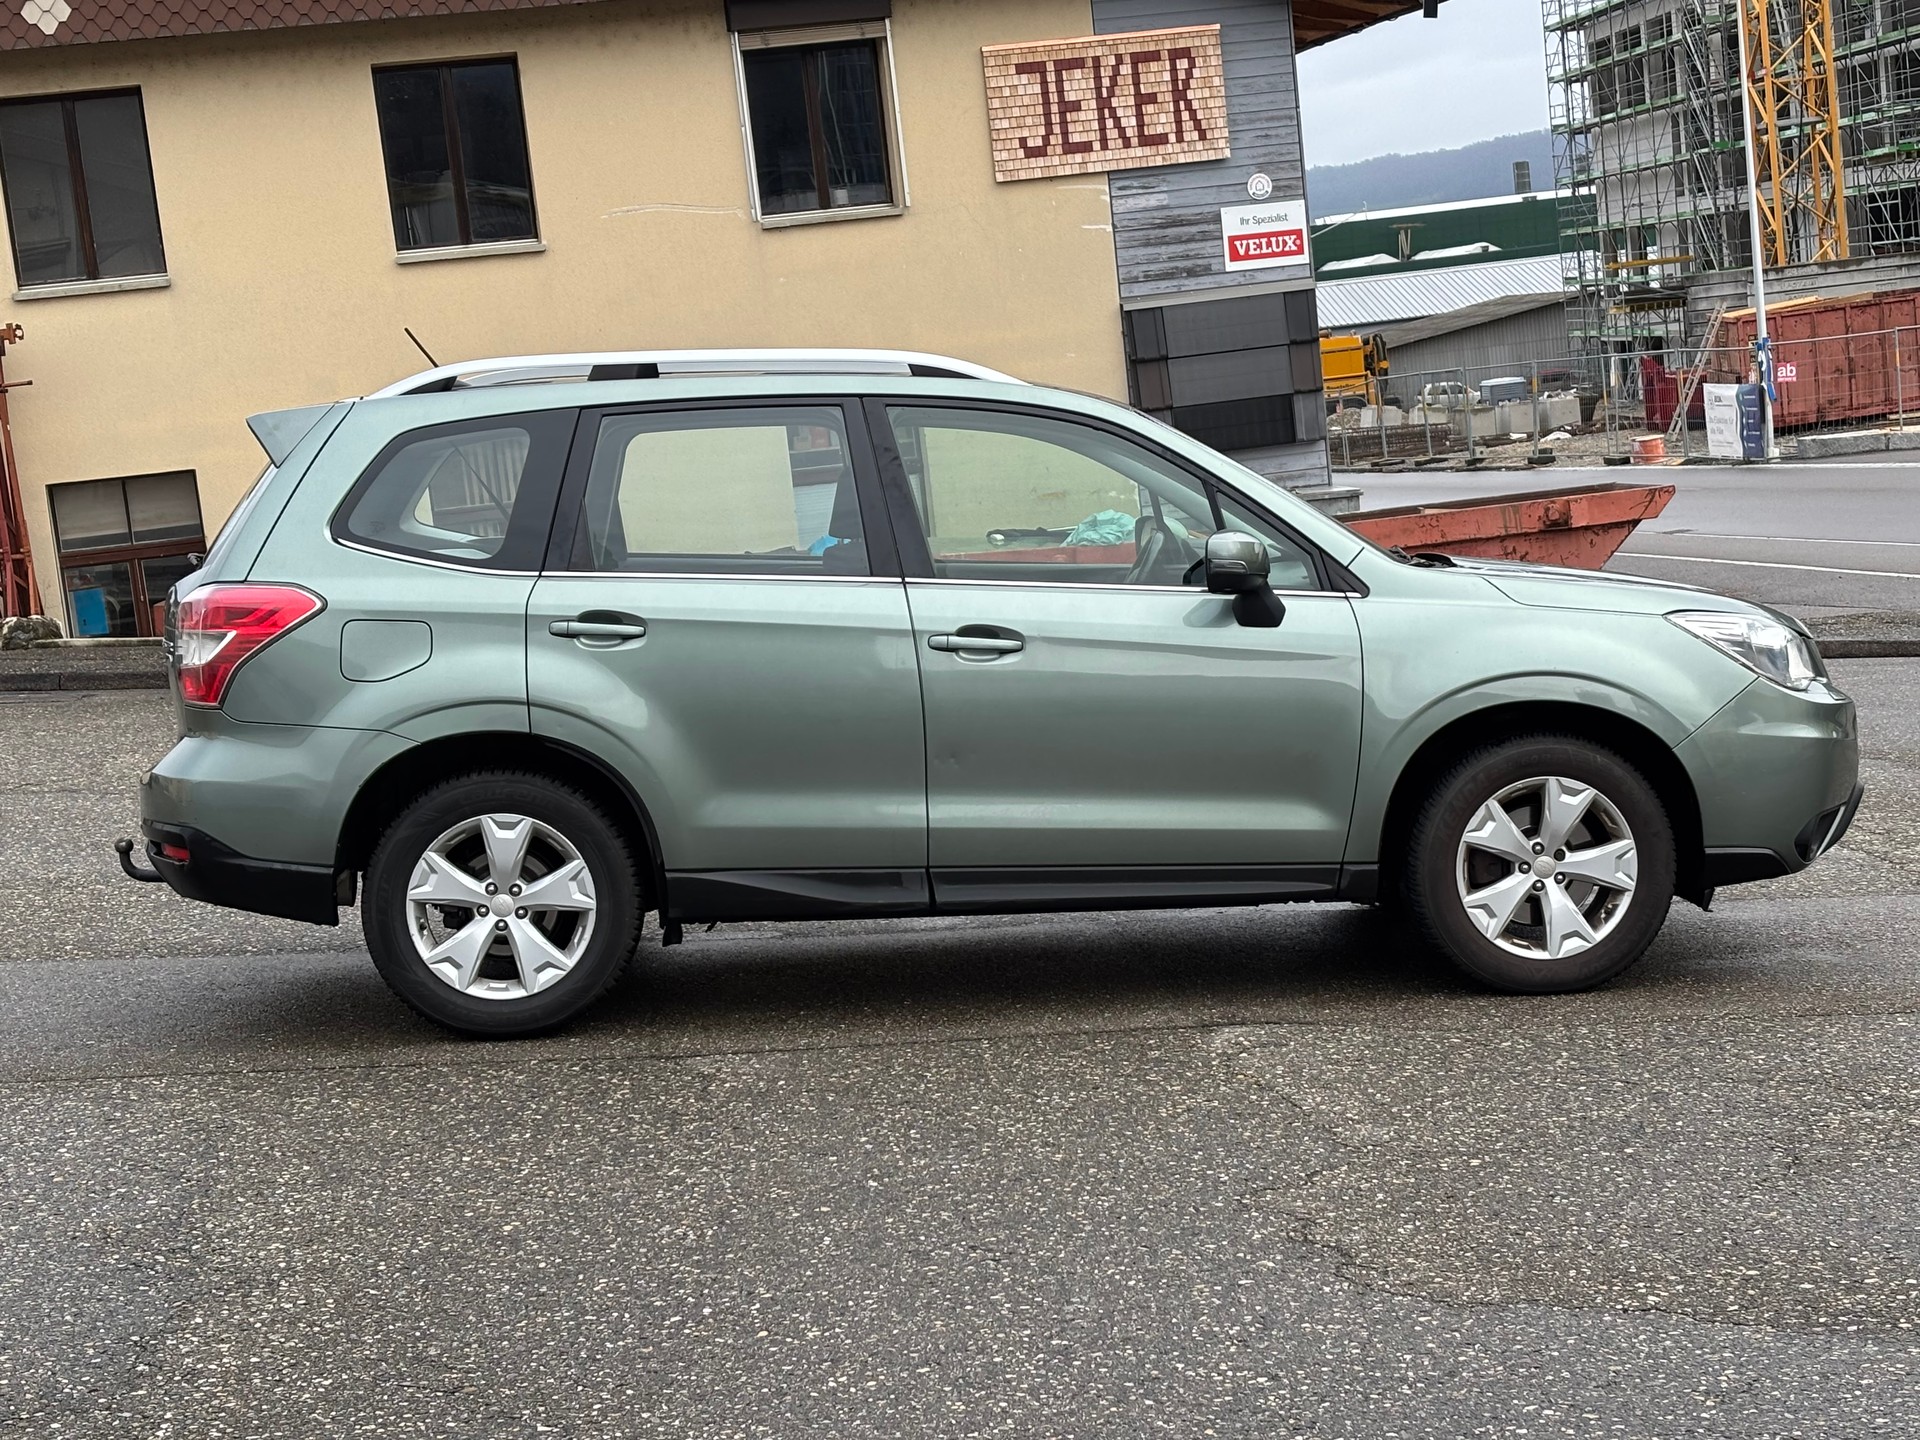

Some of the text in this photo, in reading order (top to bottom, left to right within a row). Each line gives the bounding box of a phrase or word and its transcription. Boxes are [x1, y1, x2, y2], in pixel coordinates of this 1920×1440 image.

[1015, 47, 1207, 159] JEKER
[1239, 212, 1289, 226] Ihr Spezialist
[1234, 235, 1298, 256] VELUX
[1777, 363, 1796, 377] ab
